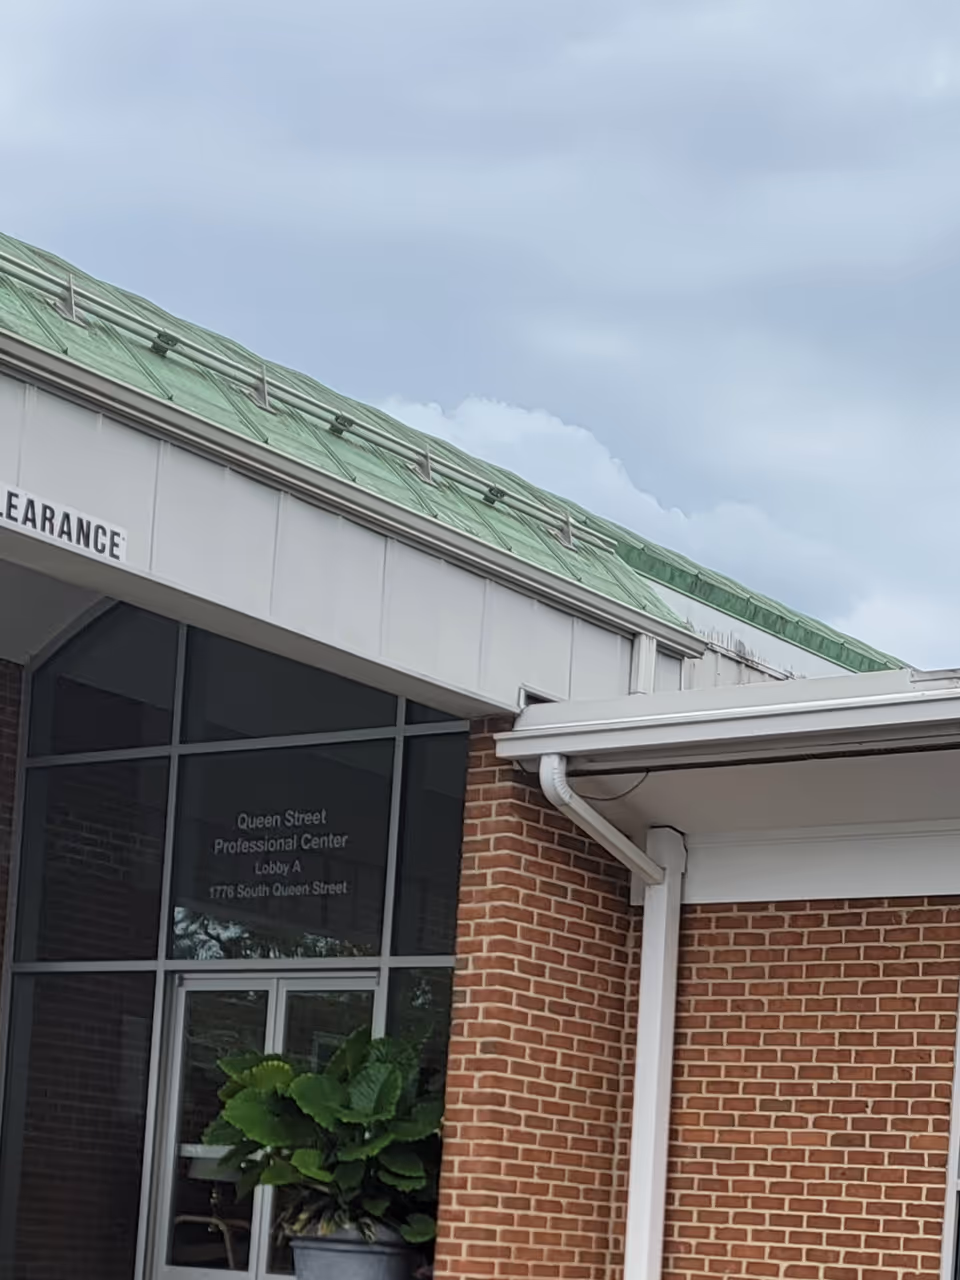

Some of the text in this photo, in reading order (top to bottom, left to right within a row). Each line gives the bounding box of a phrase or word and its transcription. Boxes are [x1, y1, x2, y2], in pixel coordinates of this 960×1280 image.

[0, 490, 121, 561] EARANCE
[237, 808, 327, 830] Queen Street
[214, 833, 348, 855] Professional Center
[255, 860, 301, 876] Lobby A
[209, 880, 347, 898] 1776 South Queen Street
